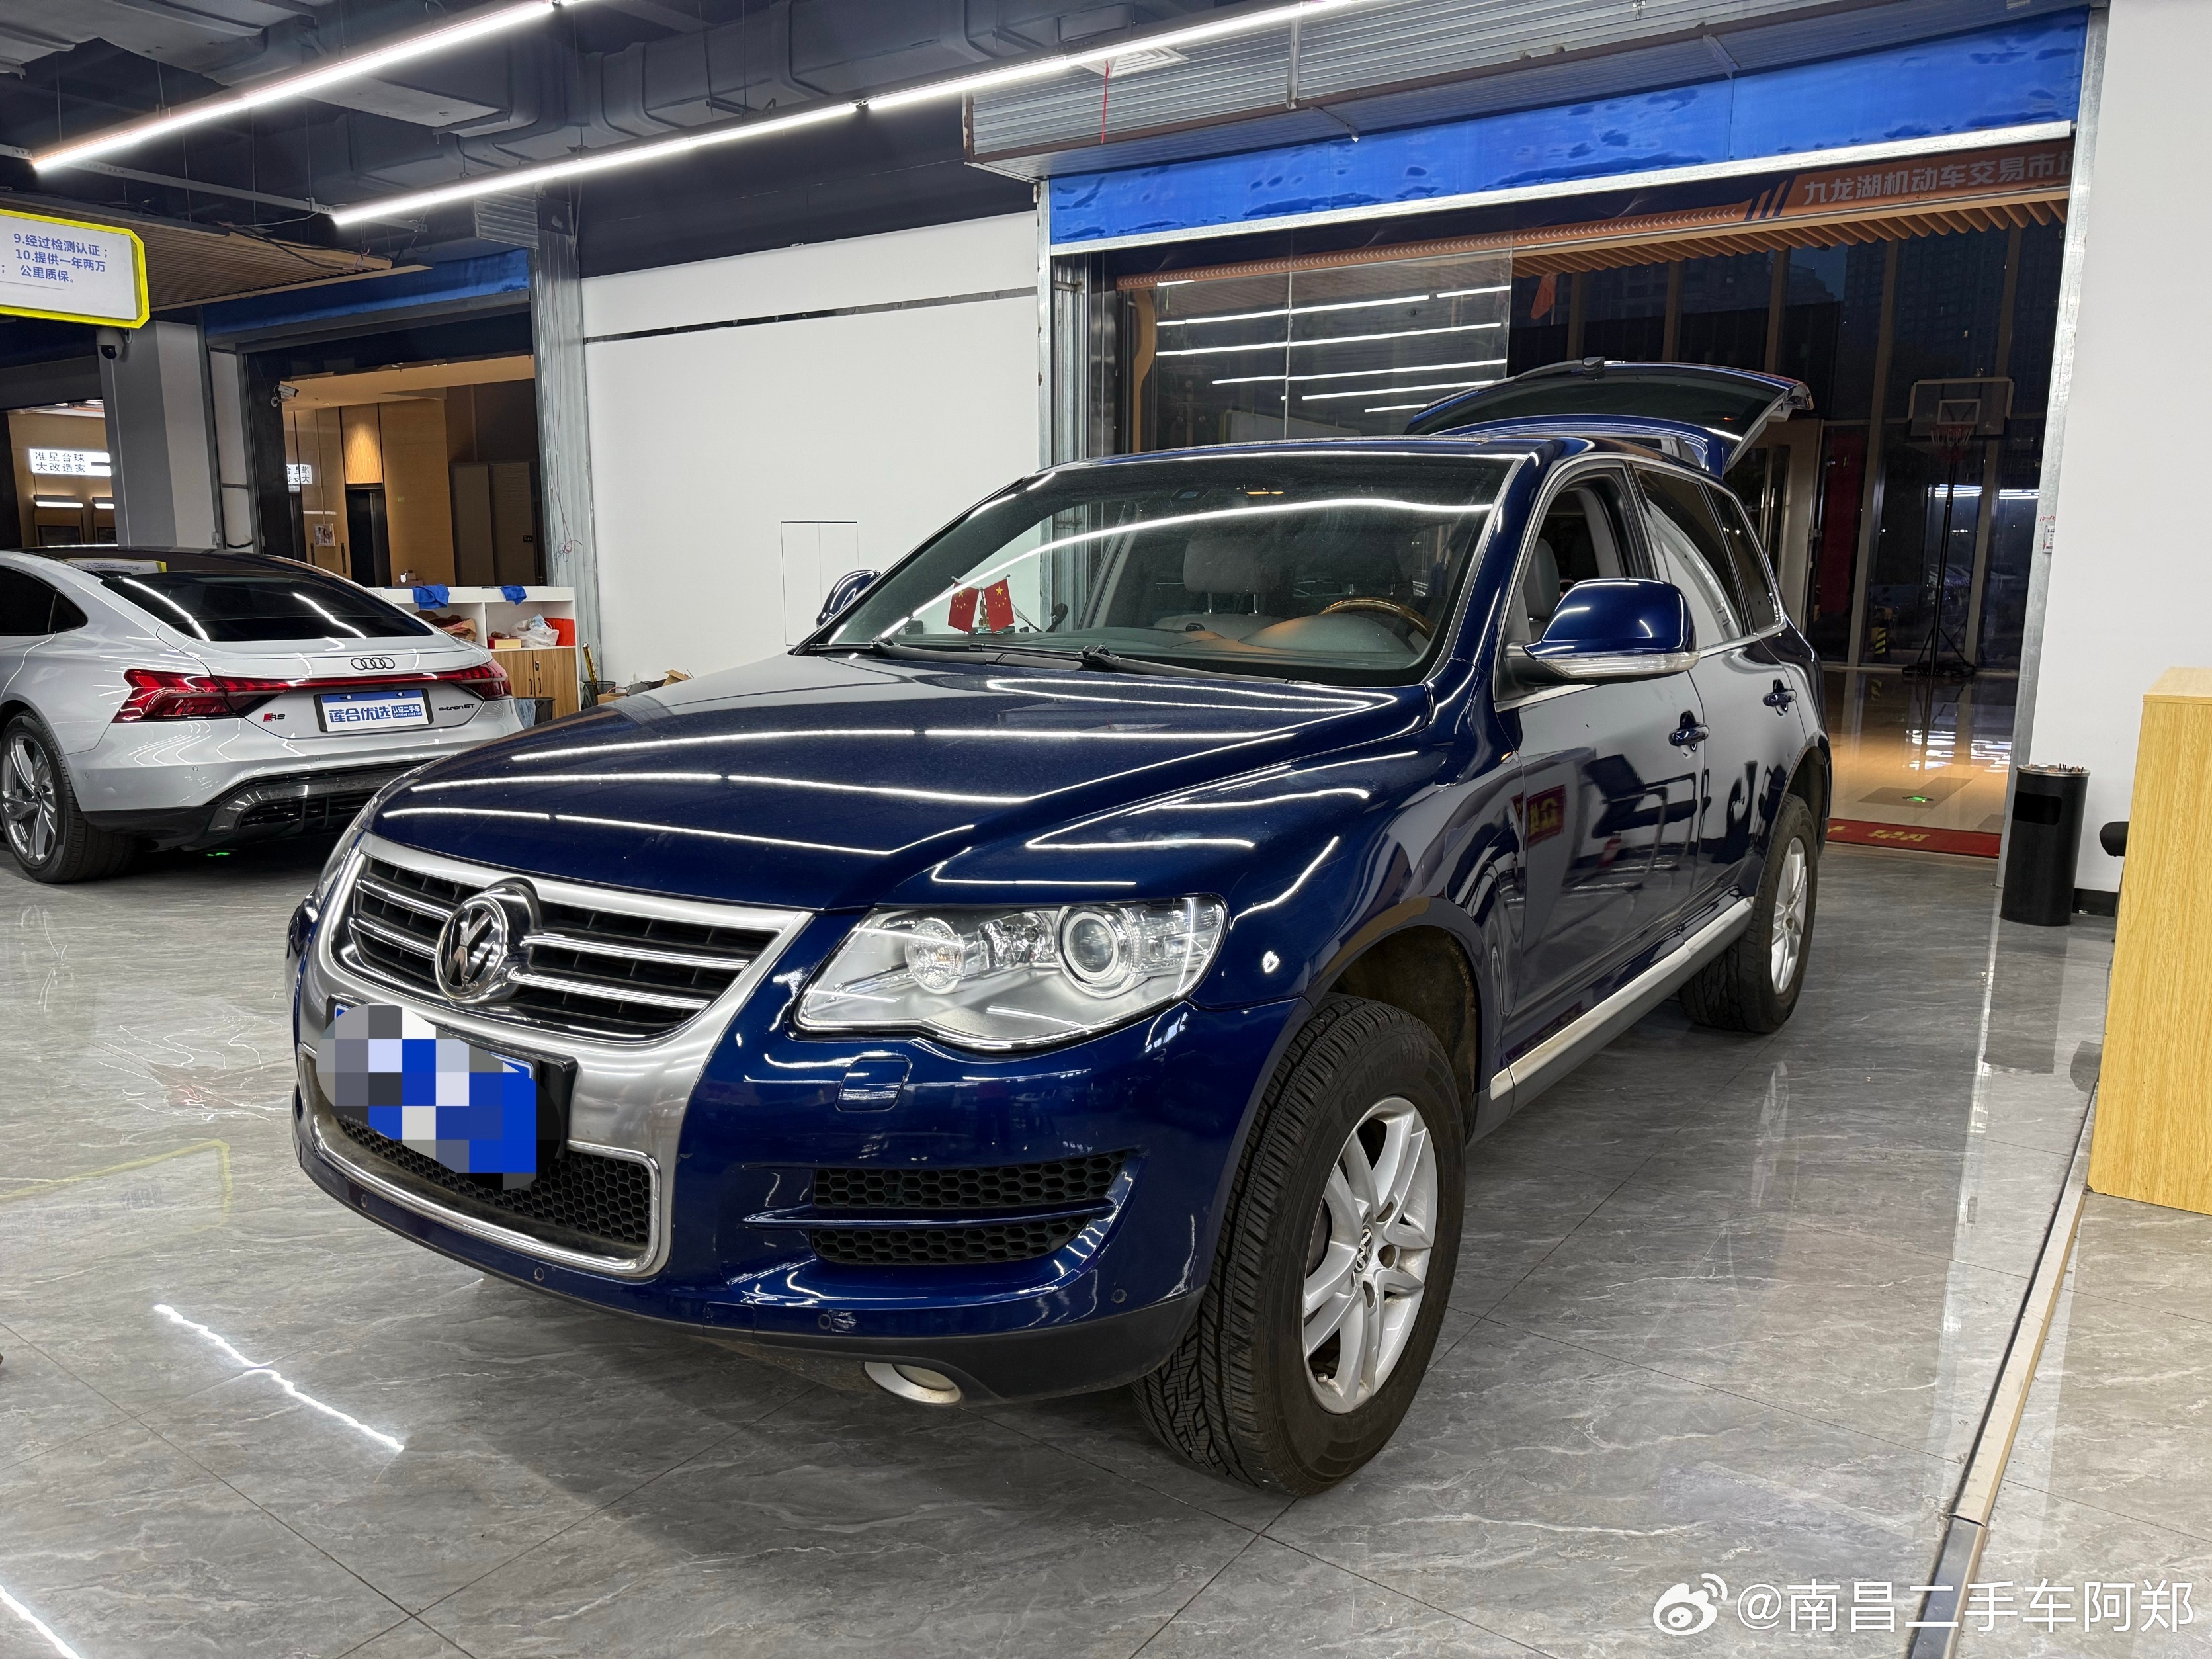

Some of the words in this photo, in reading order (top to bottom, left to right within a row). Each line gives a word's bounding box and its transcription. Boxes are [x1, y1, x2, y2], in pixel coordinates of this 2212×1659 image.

[15, 249, 106, 273] 10.提供一年两万
[20, 265, 74, 283] 公里质保。
[35, 452, 85, 462] 准星台球
[36, 462, 86, 473] 大改造家
[329, 706, 391, 723] 莲合优选
